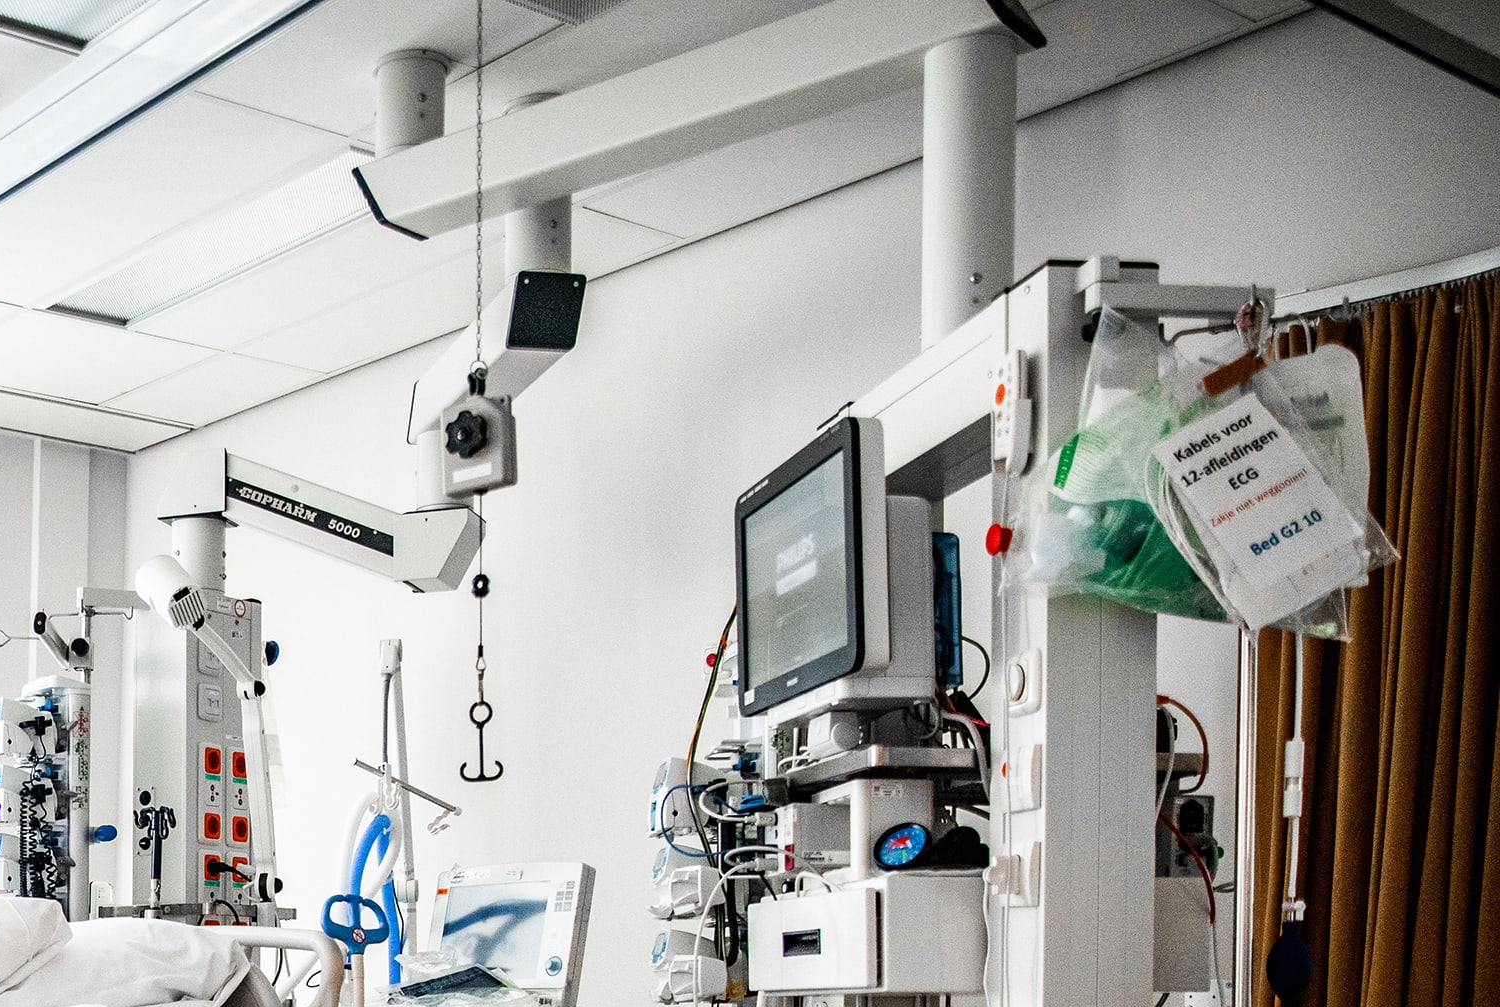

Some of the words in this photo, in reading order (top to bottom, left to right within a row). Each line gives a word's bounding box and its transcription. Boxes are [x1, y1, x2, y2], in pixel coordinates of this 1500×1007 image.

[1173, 432, 1221, 463] Kabels
[1221, 414, 1254, 437] voor
[1180, 429, 1279, 488] 12-afleidingen
[1228, 467, 1259, 491] ECG
[239, 486, 317, 523] COPHARM
[327, 518, 361, 539] 5000
[1210, 509, 1236, 528] Zakje
[1235, 498, 1255, 514] niet
[1249, 532, 1280, 556] Bed
[1280, 521, 1303, 539] G2
[1303, 509, 1323, 527] 10
